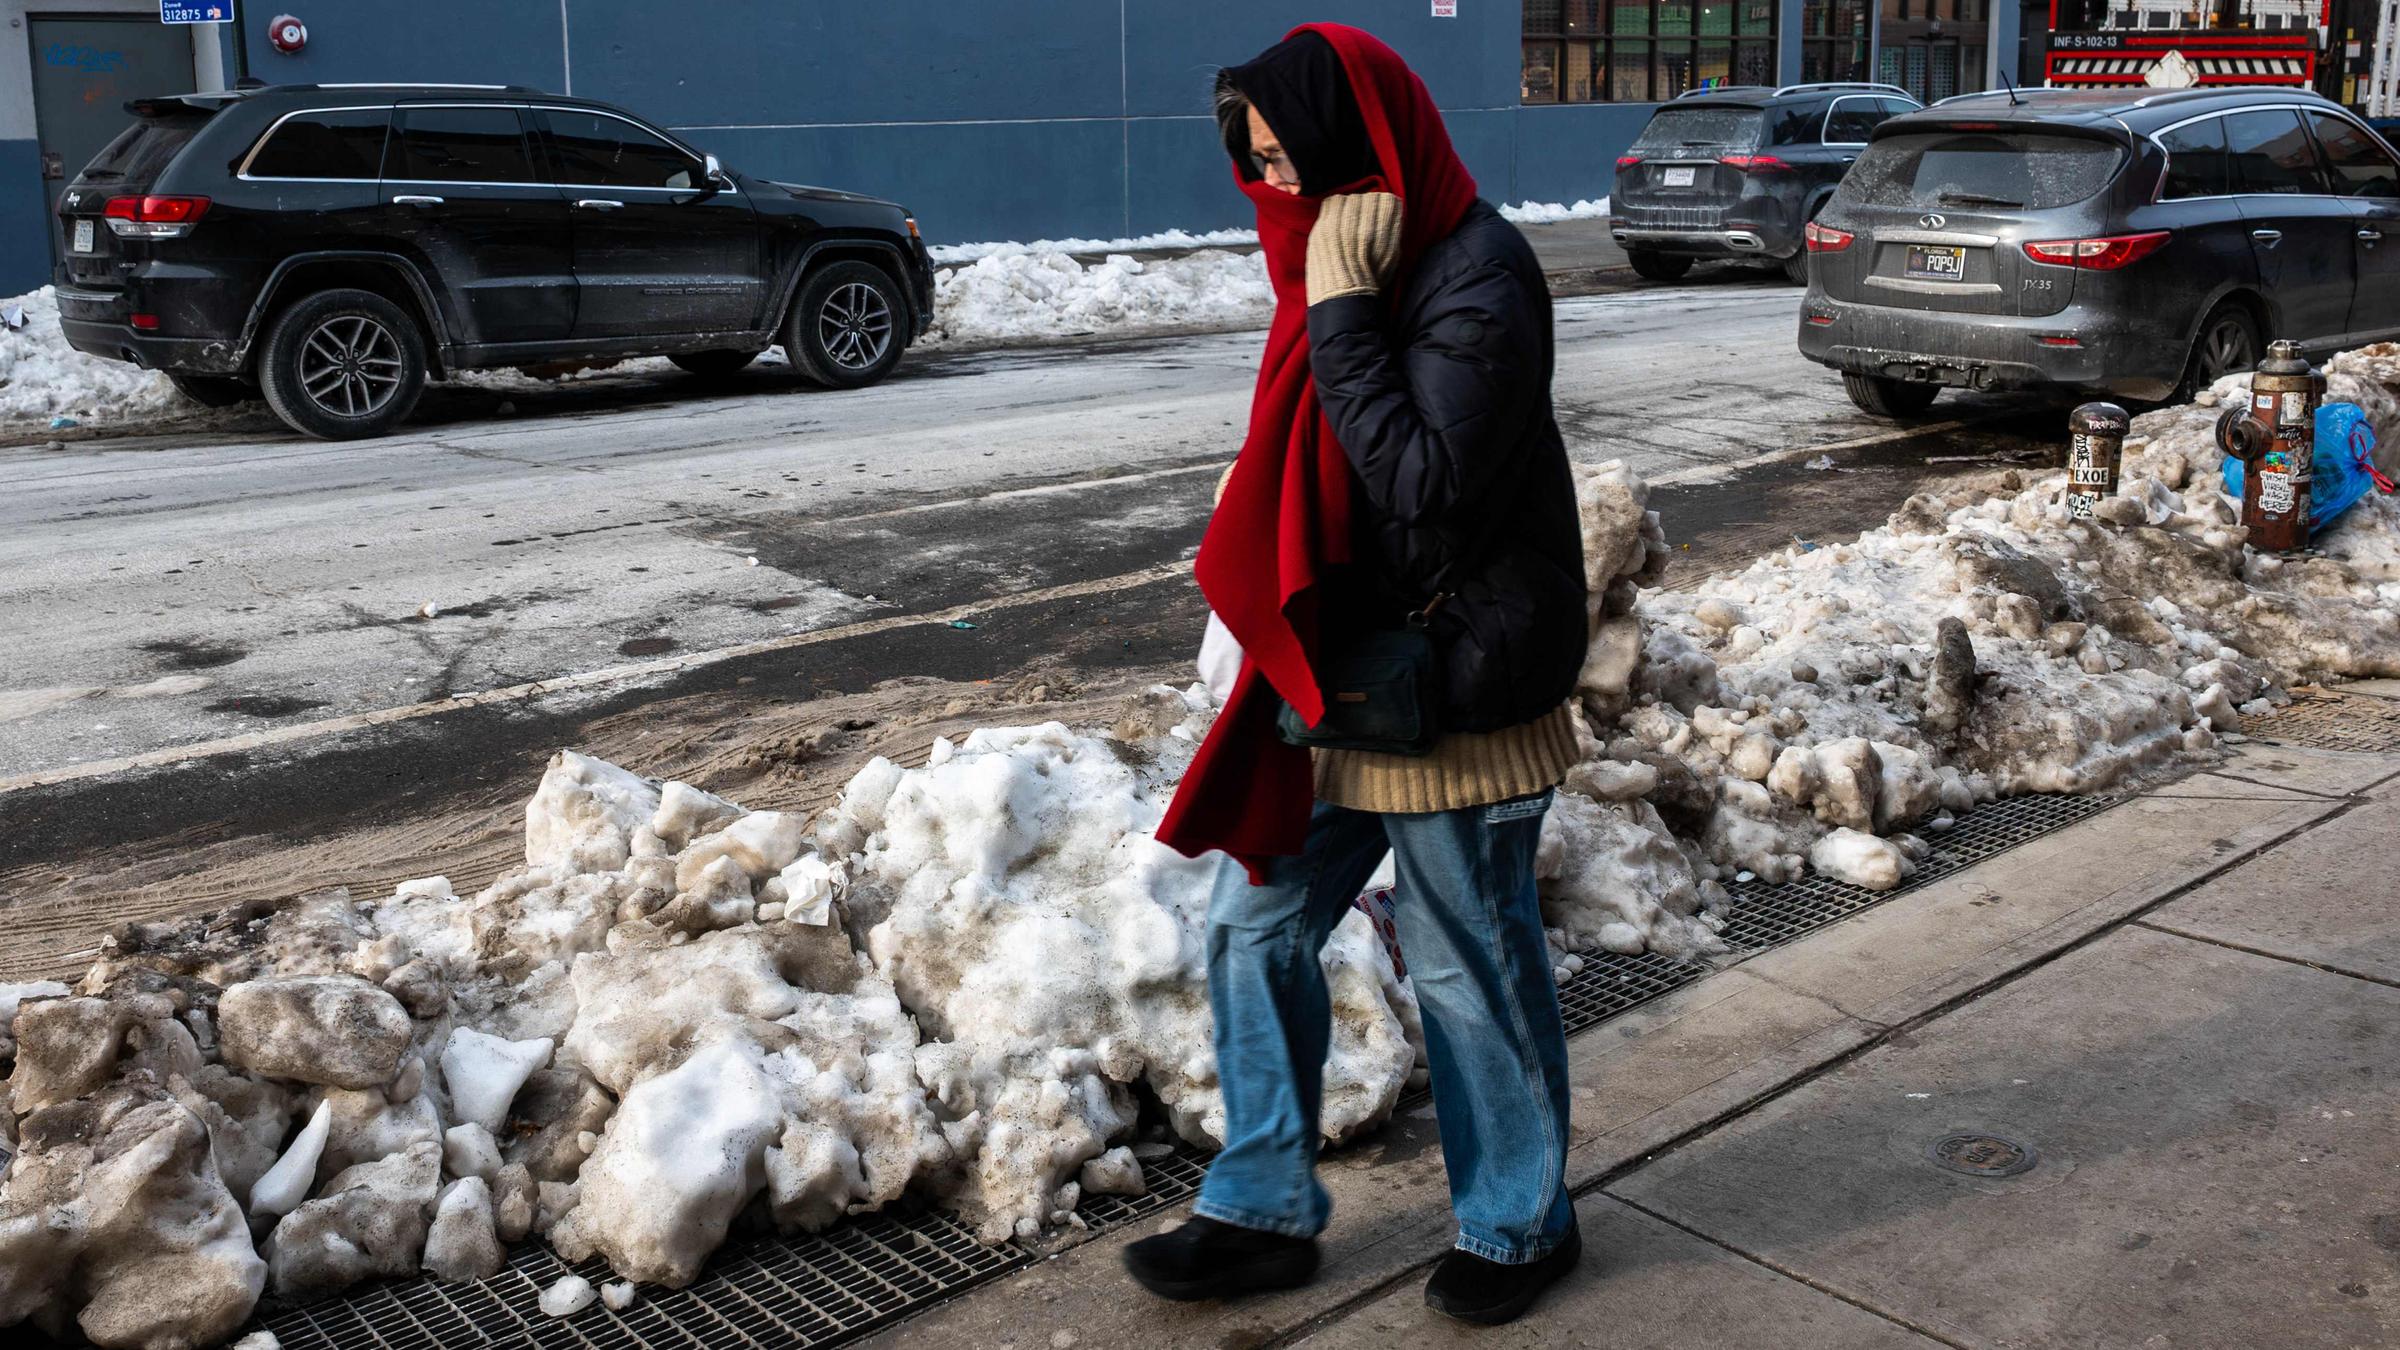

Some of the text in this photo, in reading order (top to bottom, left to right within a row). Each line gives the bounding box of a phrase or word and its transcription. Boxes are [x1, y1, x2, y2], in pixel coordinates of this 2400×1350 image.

[164, 9, 200, 20] 312875
[2054, 36, 2117, 47] INF S-102-13
[2075, 469, 2109, 482] EXOE
